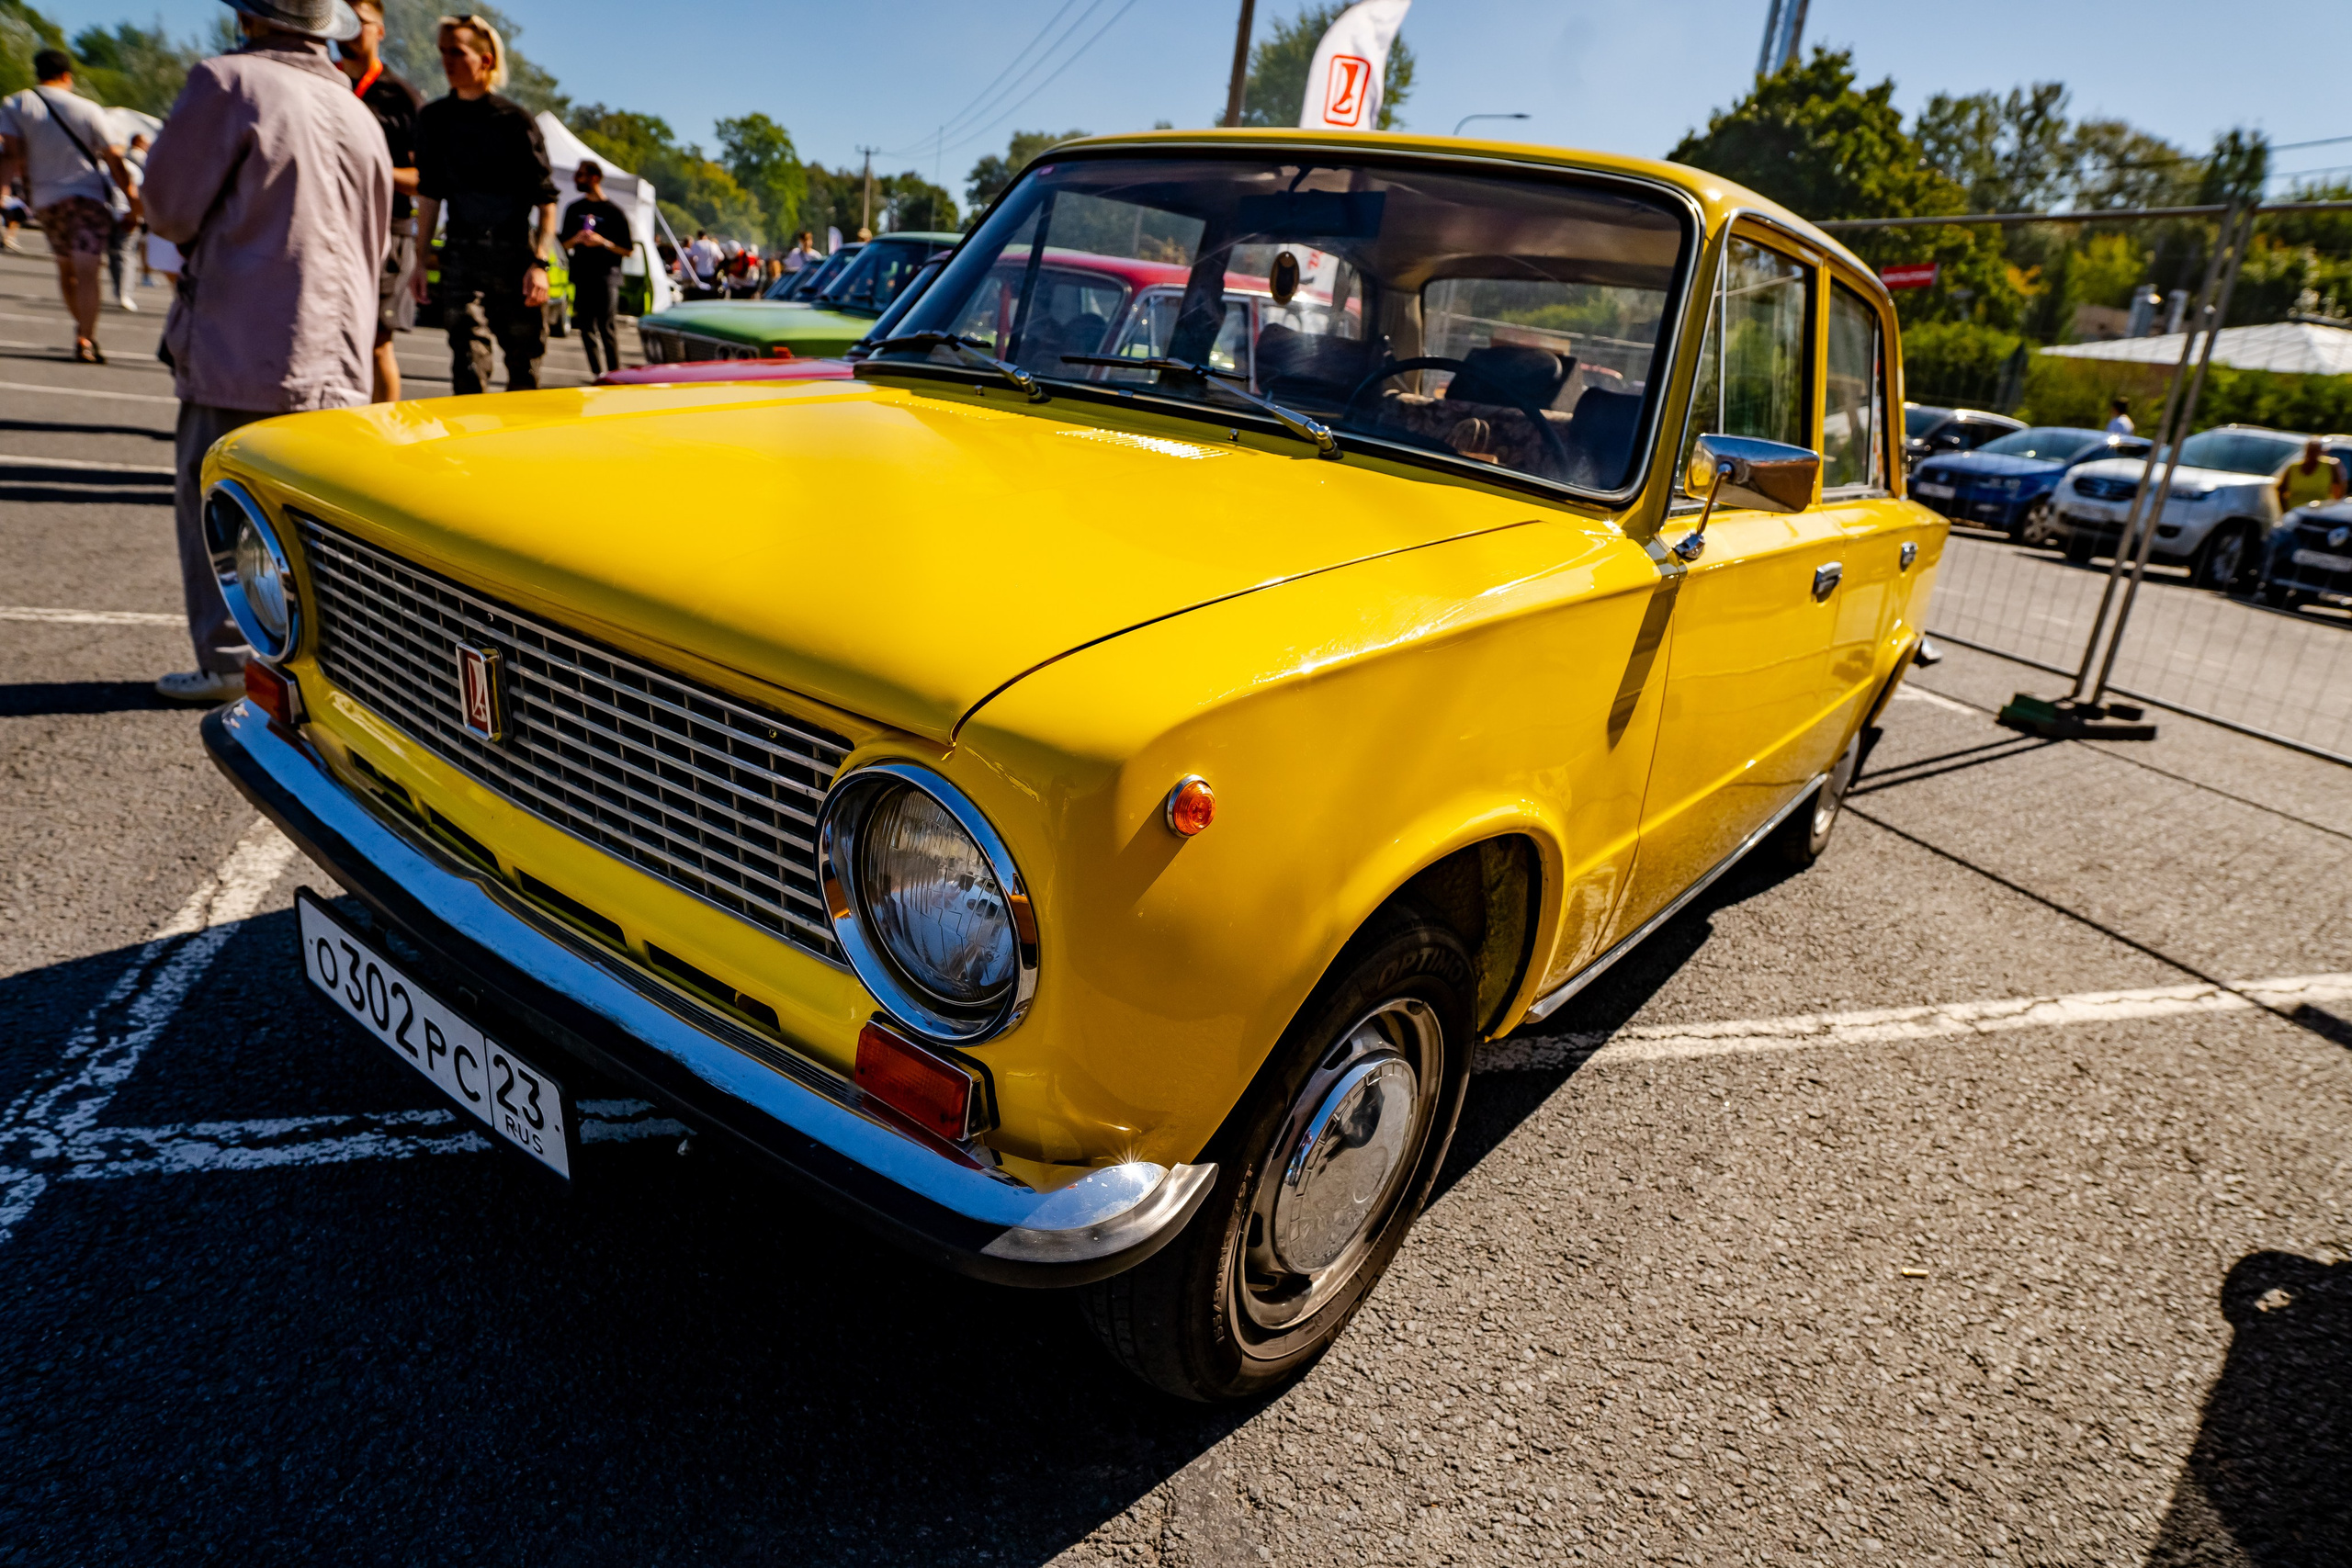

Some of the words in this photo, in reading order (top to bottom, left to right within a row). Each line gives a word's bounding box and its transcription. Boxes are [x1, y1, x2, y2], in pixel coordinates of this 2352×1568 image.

[1376, 946, 1464, 990] OPTIMO
[492, 1054, 545, 1131] 23
[504, 1113, 544, 1156] RUS
